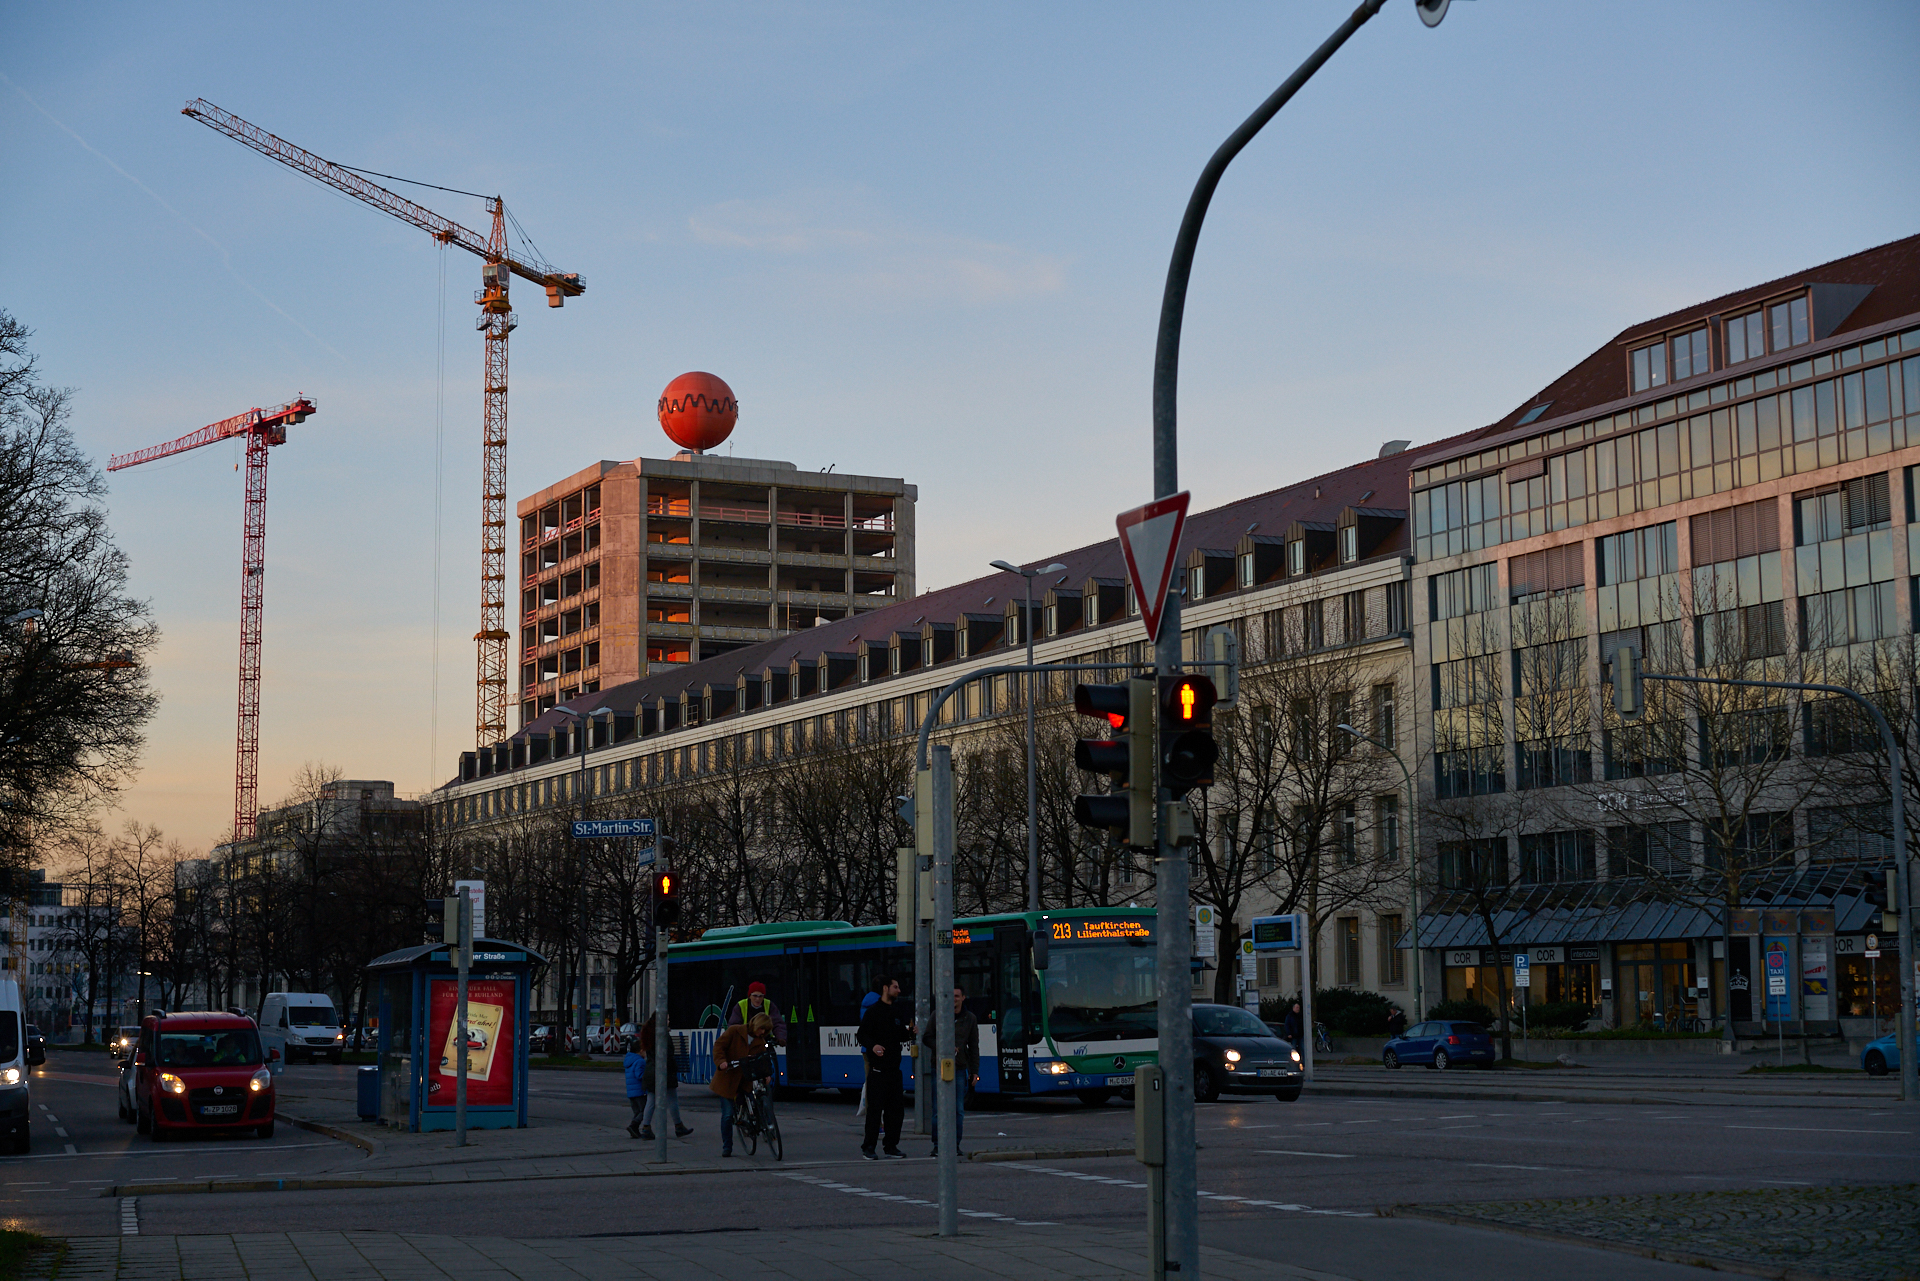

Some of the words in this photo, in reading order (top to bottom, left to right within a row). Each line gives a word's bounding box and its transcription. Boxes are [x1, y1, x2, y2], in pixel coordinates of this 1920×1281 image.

[575, 821, 652, 835] St.-Martin-Str.
[1053, 923, 1072, 939] 213
[1084, 921, 1142, 931] Taufkirchen
[1077, 929, 1150, 939] Lilienthalstraße
[1454, 952, 1471, 964] COR
[1536, 949, 1555, 961] COR
[1153, 1080, 1158, 1090] 1
